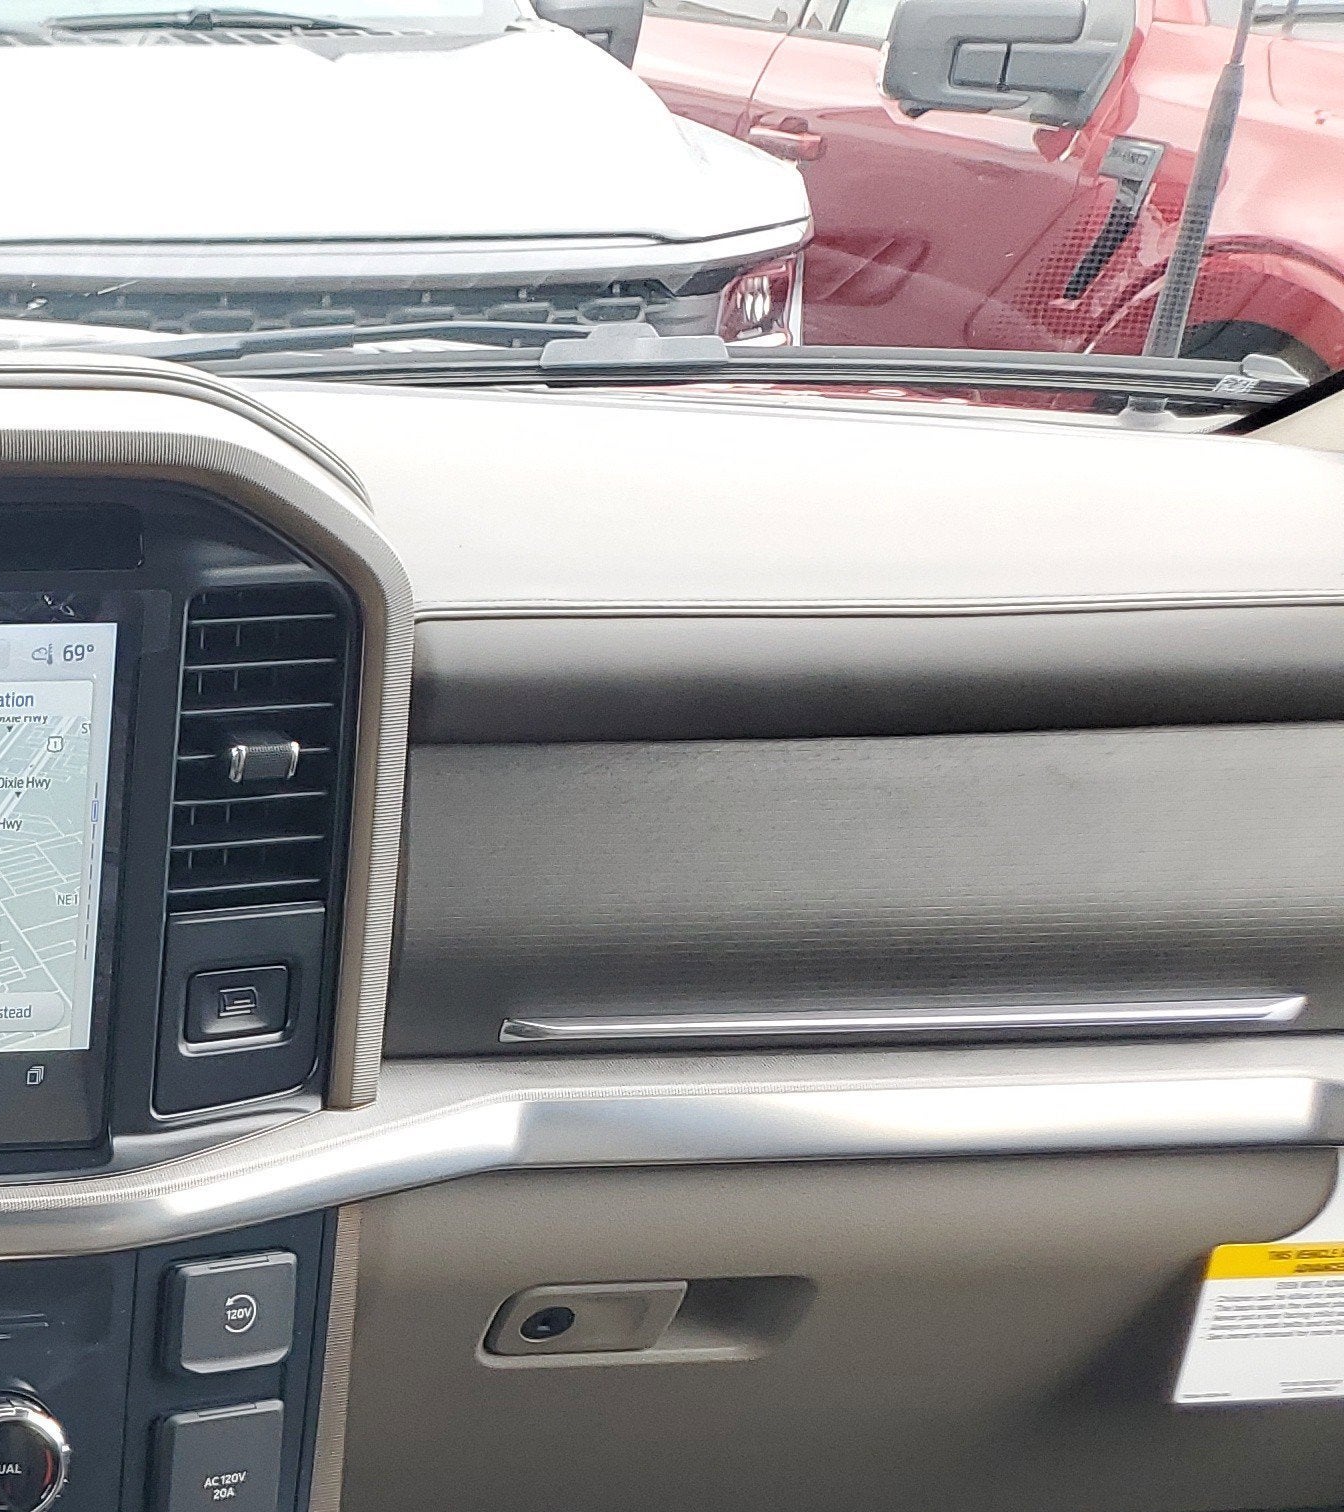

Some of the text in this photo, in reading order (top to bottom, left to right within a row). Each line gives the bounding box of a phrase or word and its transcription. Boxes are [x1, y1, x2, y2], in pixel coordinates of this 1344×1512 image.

[26, 777, 51, 790] Hwy
[226, 1306, 252, 1321] 120V
[220, 1471, 247, 1486] 120V
[214, 1488, 235, 1500] 20A
